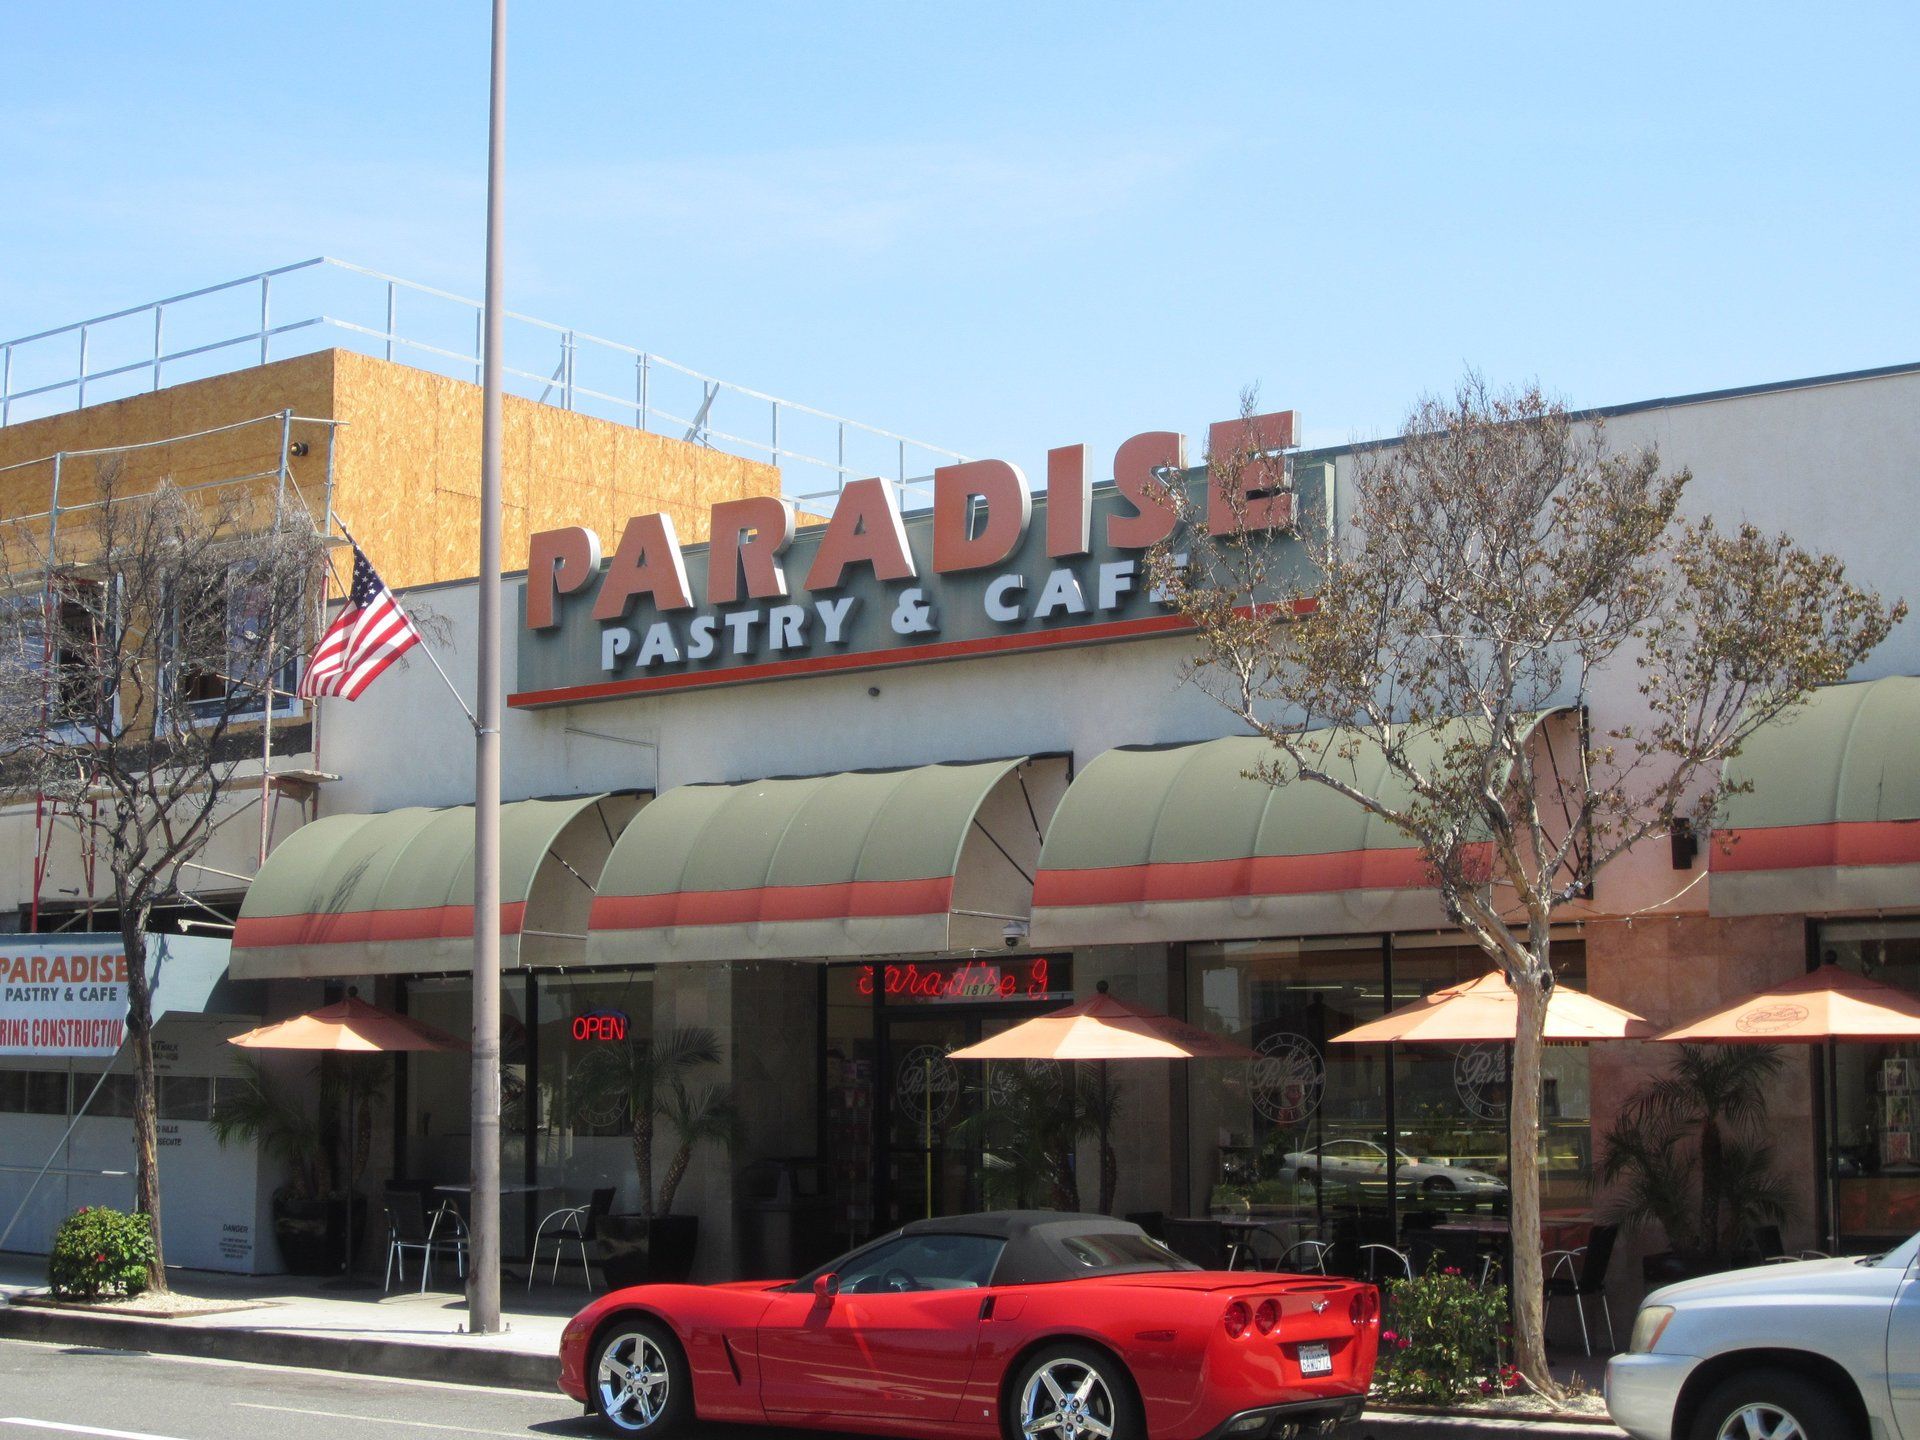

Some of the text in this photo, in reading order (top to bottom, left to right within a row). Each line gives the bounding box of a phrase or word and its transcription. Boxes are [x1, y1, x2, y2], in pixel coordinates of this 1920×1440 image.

[526, 410, 1296, 629] PARADISE
[602, 597, 855, 670] PASTRY
[891, 588, 933, 634] &
[0, 955, 128, 983] PARADISE
[5, 986, 118, 1001] PASTRY & CAFE
[965, 984, 996, 996] 1817
[32, 1018, 124, 1047] CONSTRUCTION
[572, 1016, 624, 1040] OPEN
